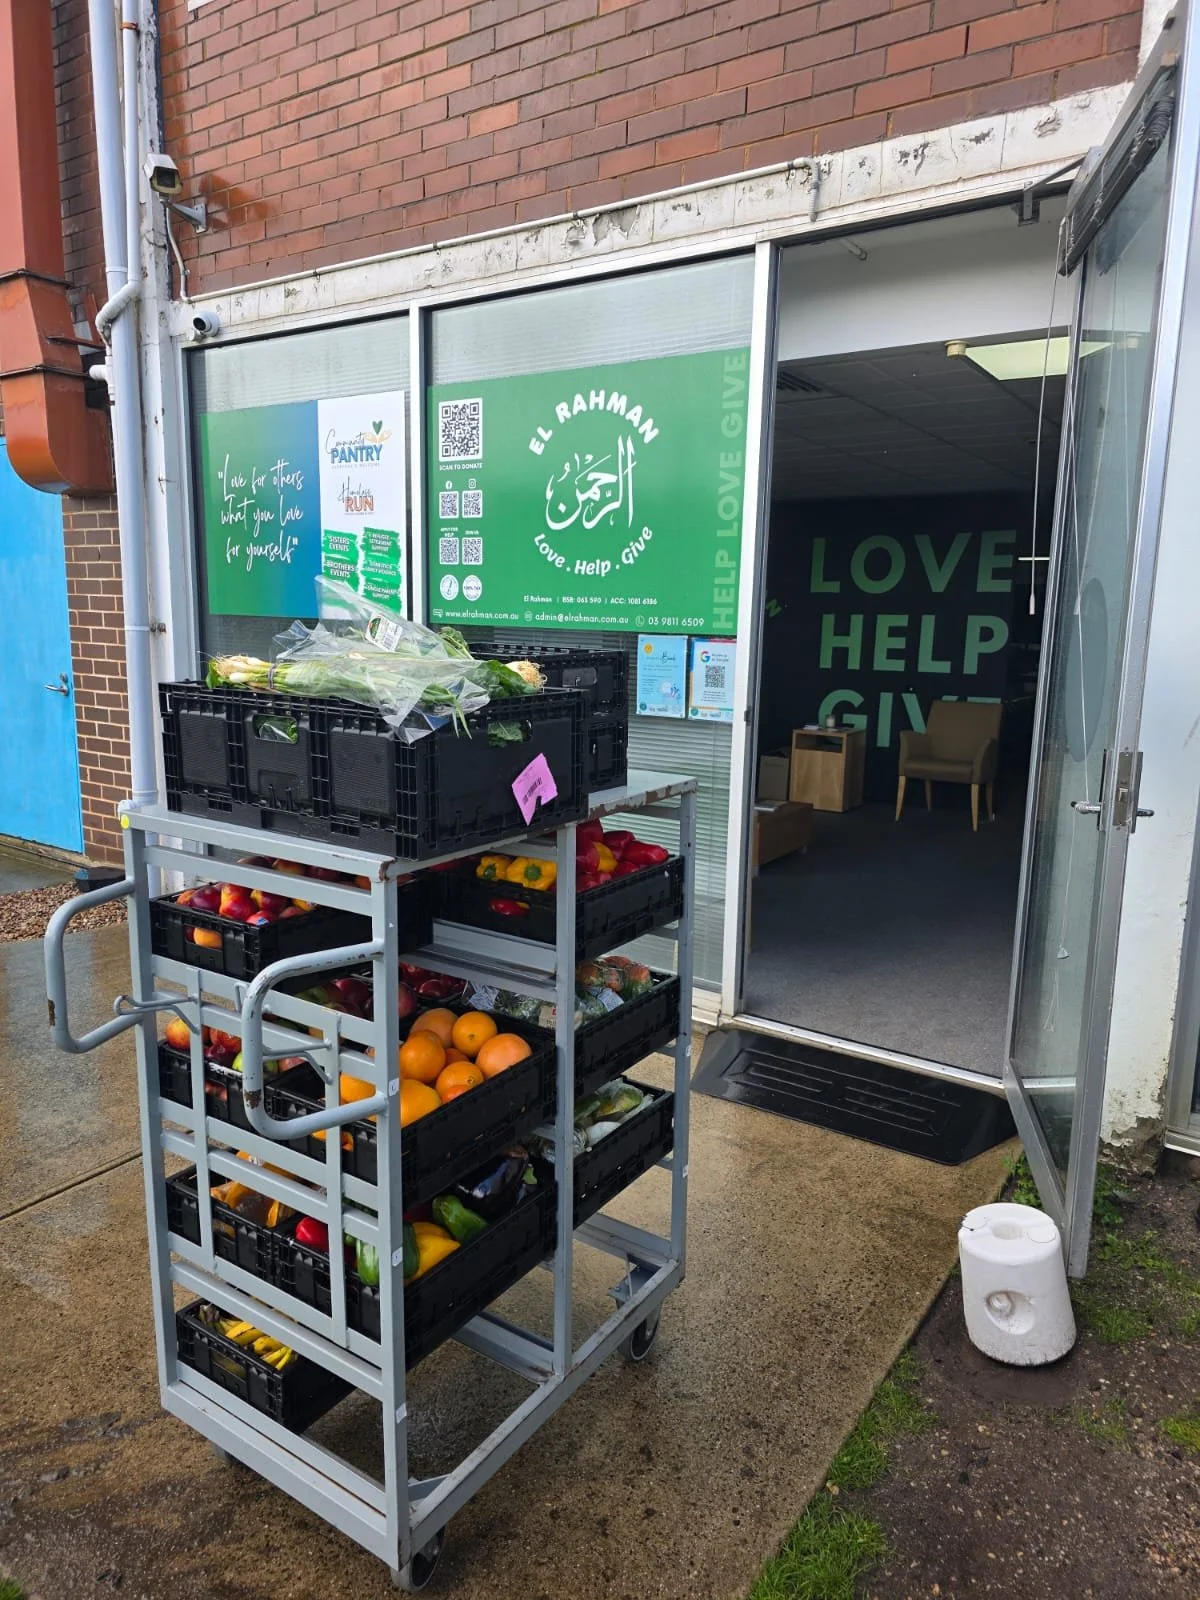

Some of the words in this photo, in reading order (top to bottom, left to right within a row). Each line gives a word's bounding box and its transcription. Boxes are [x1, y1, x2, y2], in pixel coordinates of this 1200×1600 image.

[721, 353, 746, 438] GIVE
[529, 426, 553, 456] EL
[555, 390, 659, 444] RAHMAN
[251, 467, 267, 495] for
[270, 459, 304, 494] others
[331, 444, 383, 464] PANTRY
[461, 462, 483, 470] DONATE
[345, 495, 375, 512] RUN
[717, 450, 742, 537] LOVE
[220, 497, 256, 530] what
[253, 508, 275, 538] you
[226, 536, 241, 564] for
[246, 529, 299, 572] yourself"
[329, 543, 350, 552] EVENTS
[534, 533, 566, 568] Love
[574, 559, 611, 577] Help
[621, 526, 653, 565] Give
[809, 529, 1017, 594] LOVE
[712, 548, 737, 629] HELP
[445, 608, 519, 620] www.elrahman.com.au
[535, 611, 629, 624] admin@elrahman.com.au
[648, 616, 659, 626] 03
[661, 616, 679, 626] 9811
[681, 617, 705, 627] 6509
[819, 614, 1010, 675] HELP
[817, 688, 1002, 748] GIV
